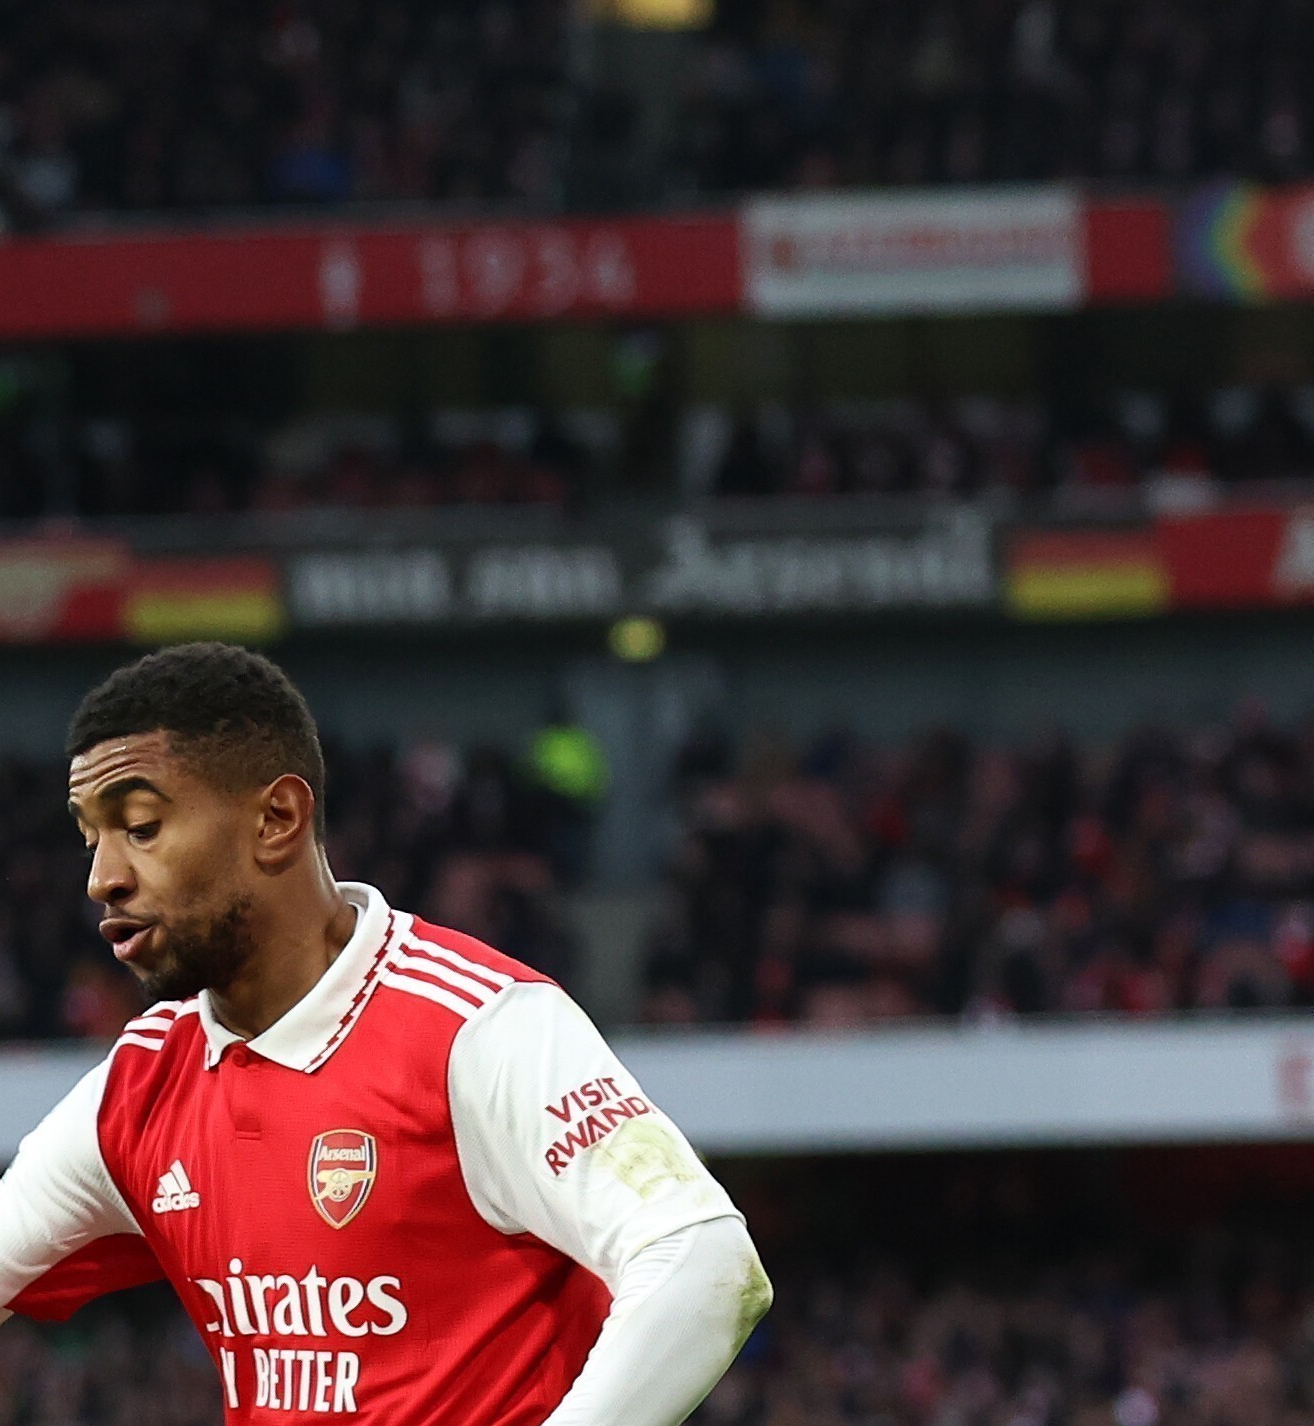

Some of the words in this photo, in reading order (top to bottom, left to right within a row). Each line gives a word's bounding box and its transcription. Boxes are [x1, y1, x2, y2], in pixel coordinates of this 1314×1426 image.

[545, 1077, 622, 1123] VISIT
[320, 1145, 366, 1162] Arsenal
[544, 1096, 657, 1176] RWAND
[253, 1348, 359, 1413] BETTER
